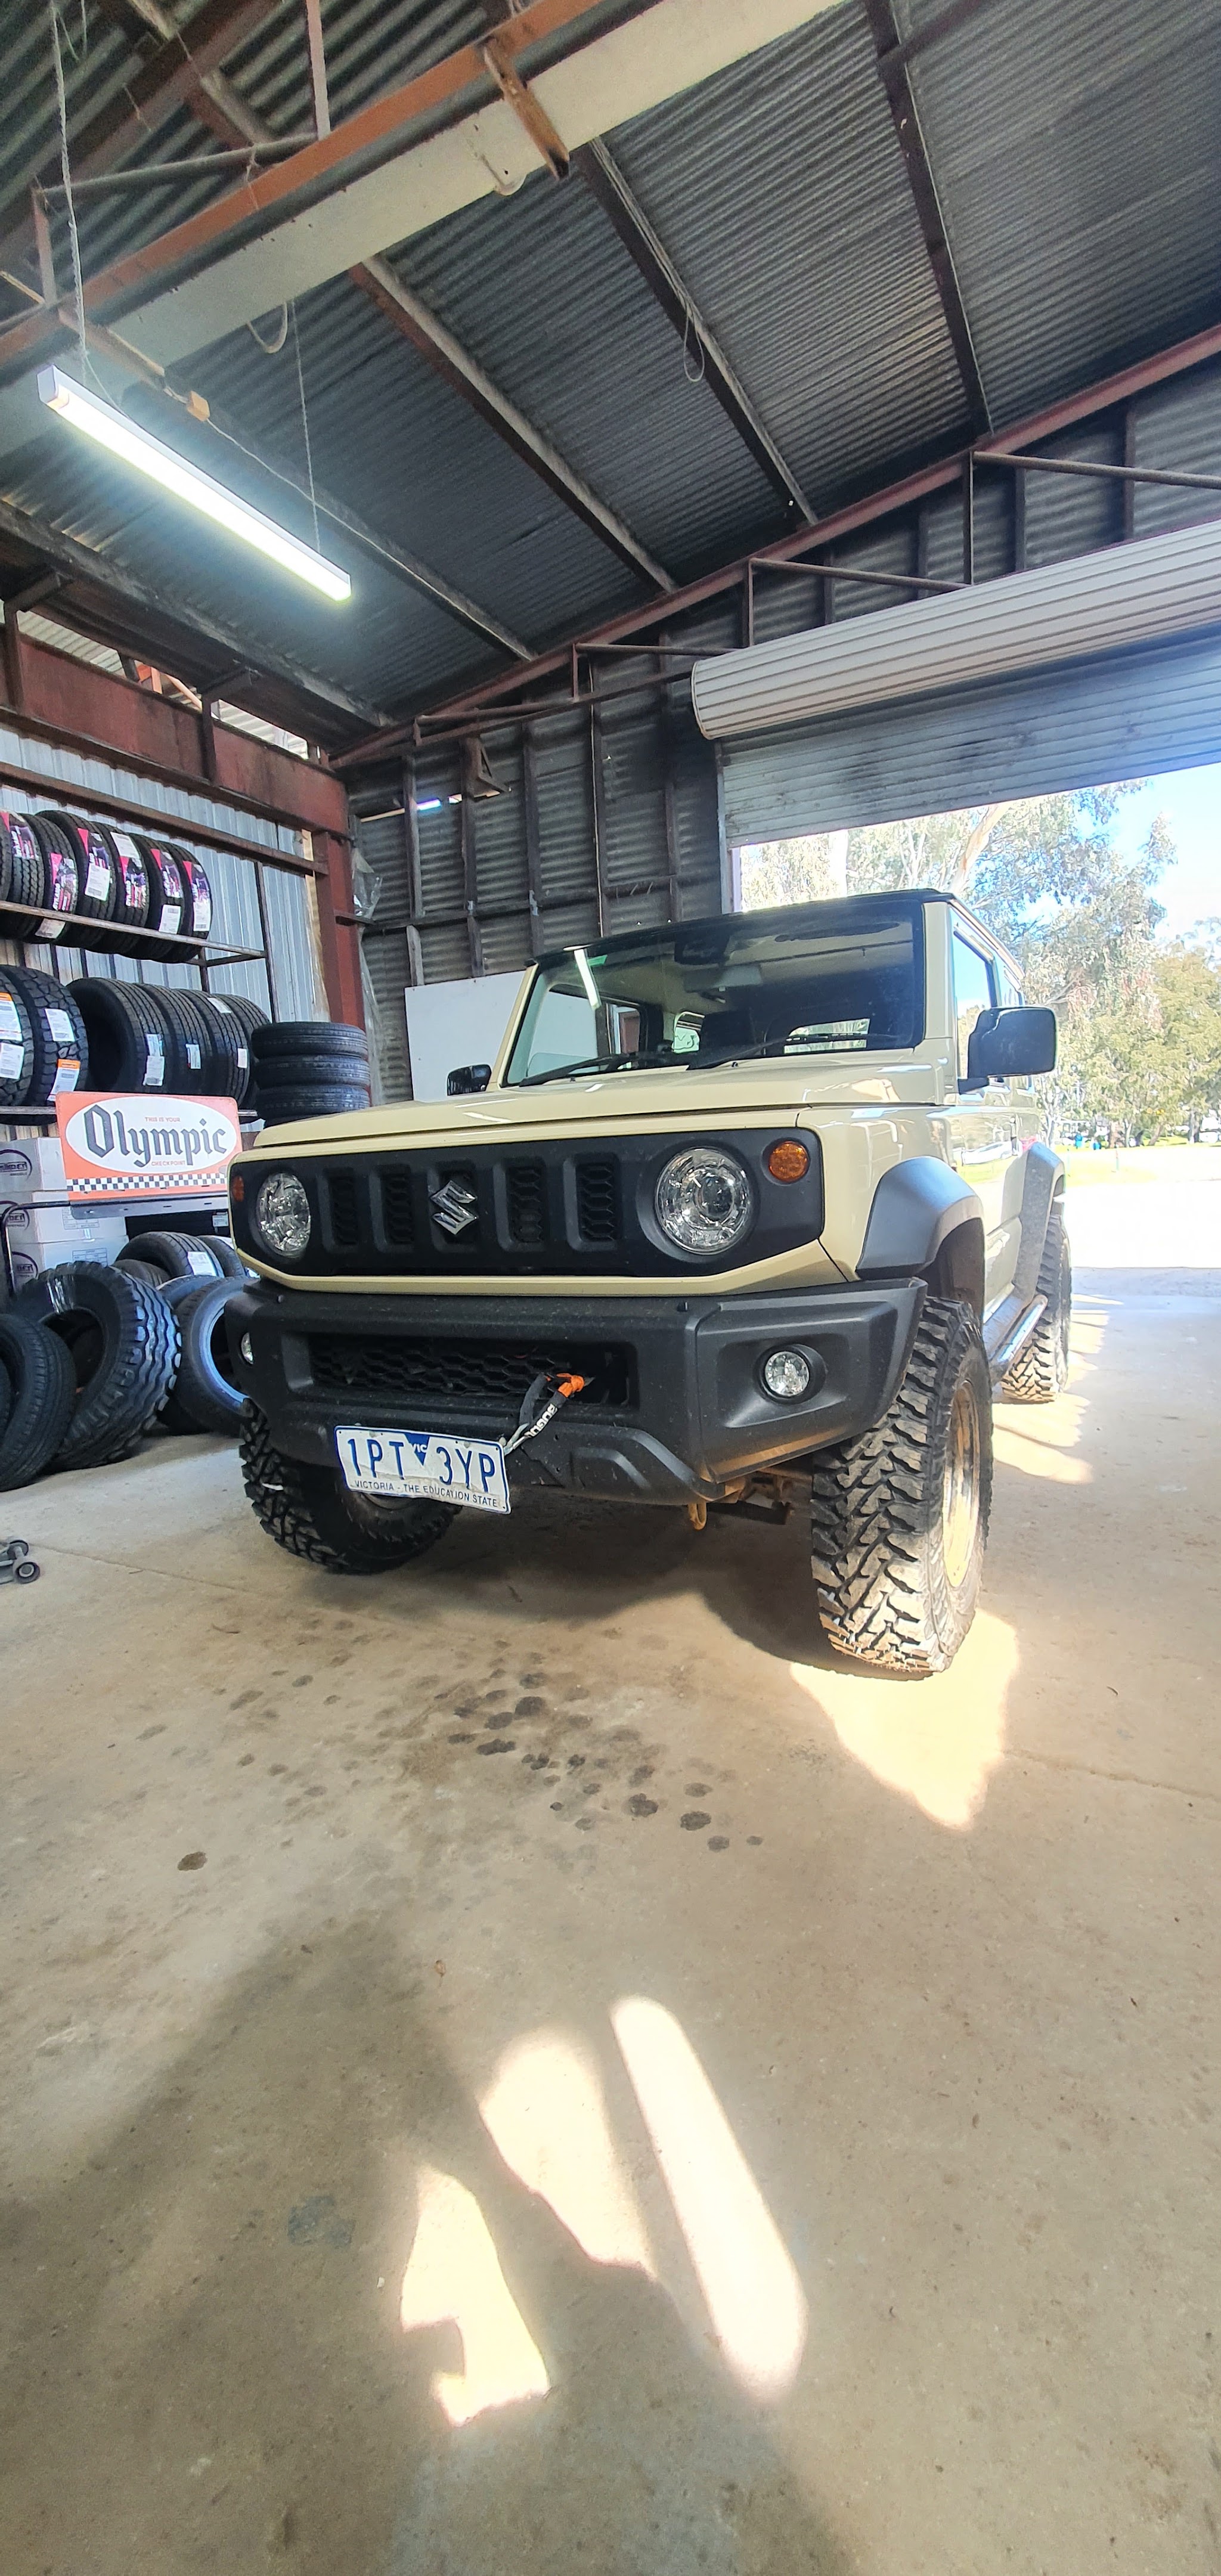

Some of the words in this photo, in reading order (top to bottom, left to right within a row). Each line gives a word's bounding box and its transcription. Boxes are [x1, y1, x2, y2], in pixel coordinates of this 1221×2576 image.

[83, 1104, 227, 1167] Olympic
[348, 1439, 404, 1480] 1PT
[436, 1447, 495, 1493] 3YP
[354, 1480, 393, 1490] VICTORIA
[404, 1484, 420, 1493] THE
[423, 1486, 469, 1501] EDUCATION
[473, 1495, 497, 1507] STATE
